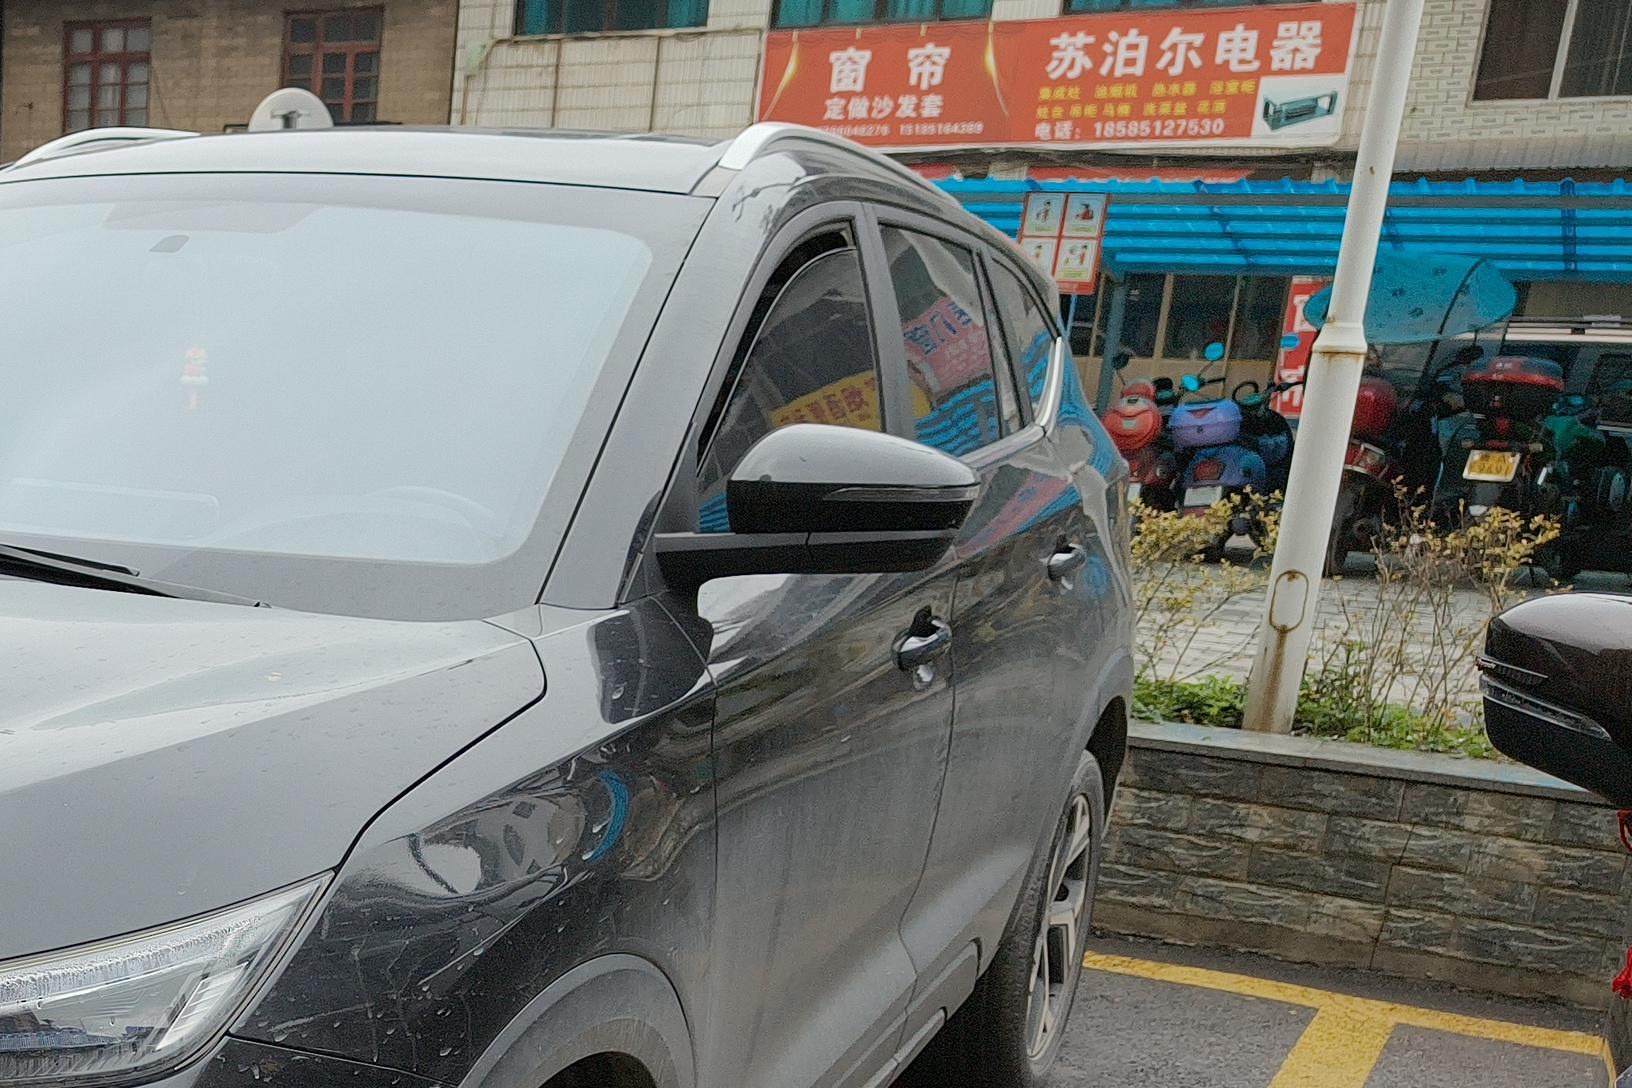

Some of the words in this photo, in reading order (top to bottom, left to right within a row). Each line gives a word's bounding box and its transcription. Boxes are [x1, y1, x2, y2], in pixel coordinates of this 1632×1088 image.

[1045, 21, 1323, 80] 苏泊尔电器
[823, 94, 944, 120] 定做沙发套
[1094, 118, 1225, 138] 18585127530
